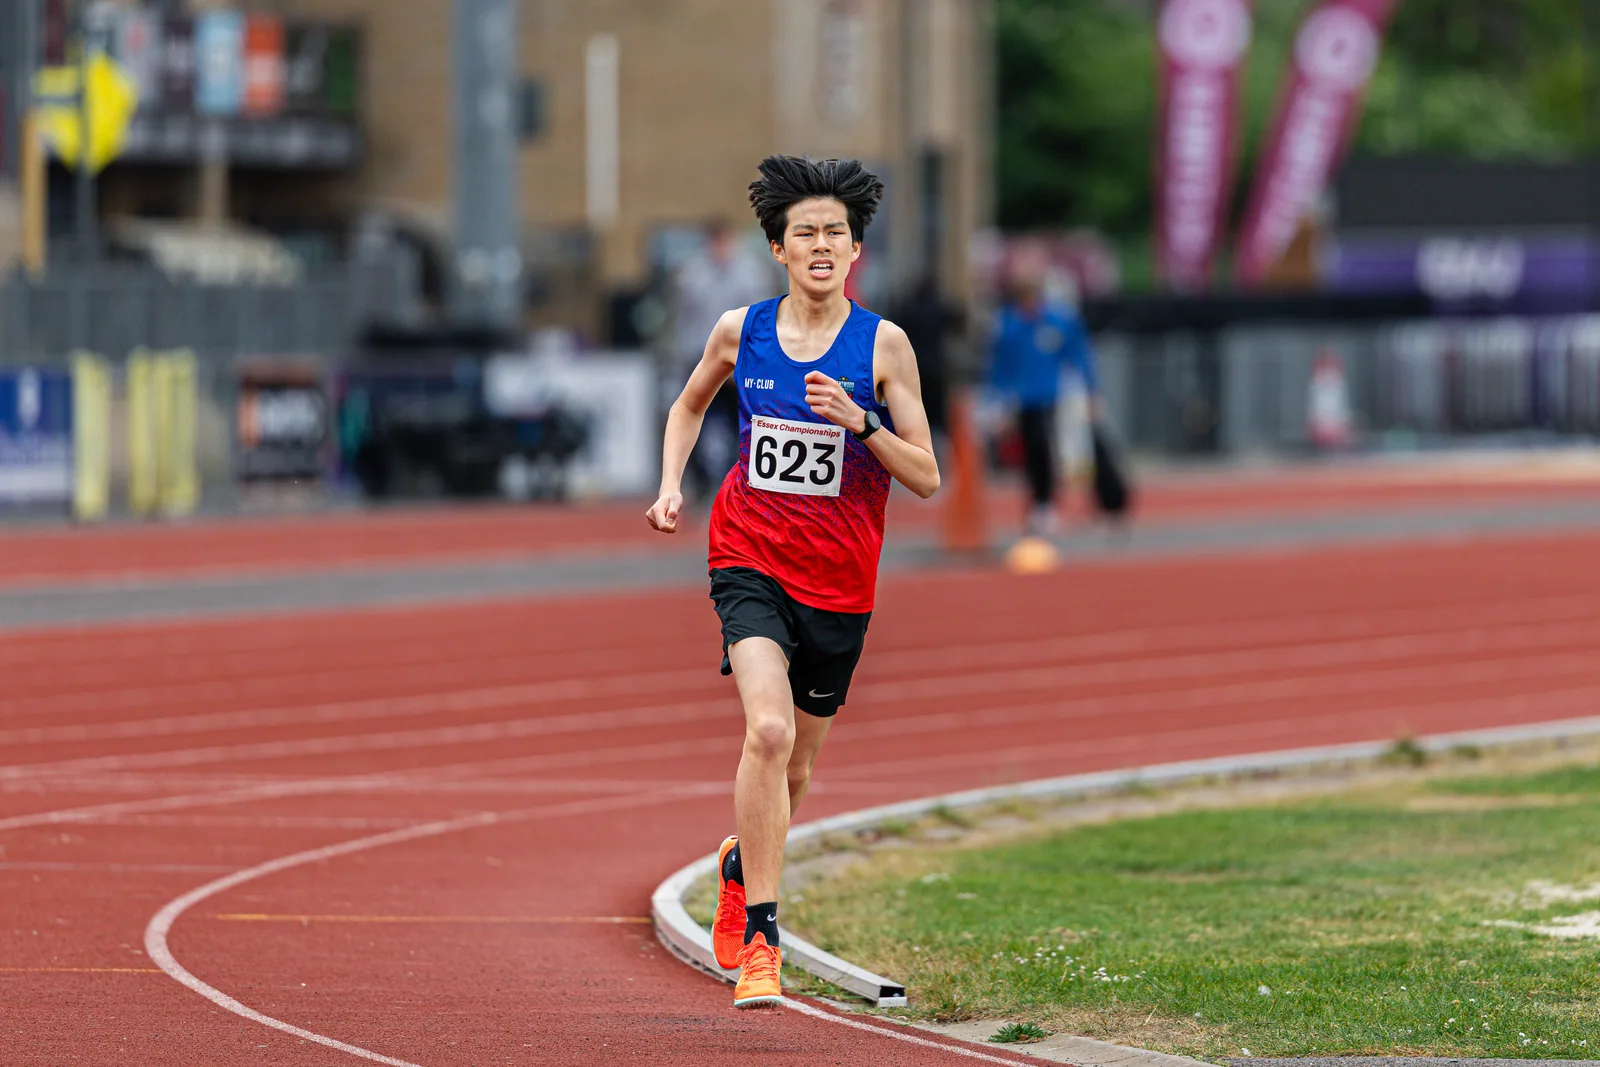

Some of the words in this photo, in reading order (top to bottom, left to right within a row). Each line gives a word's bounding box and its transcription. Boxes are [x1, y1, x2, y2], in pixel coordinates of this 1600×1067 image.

[757, 420, 778, 430] Essex
[779, 423, 841, 438] Championships
[755, 435, 836, 485] 623
